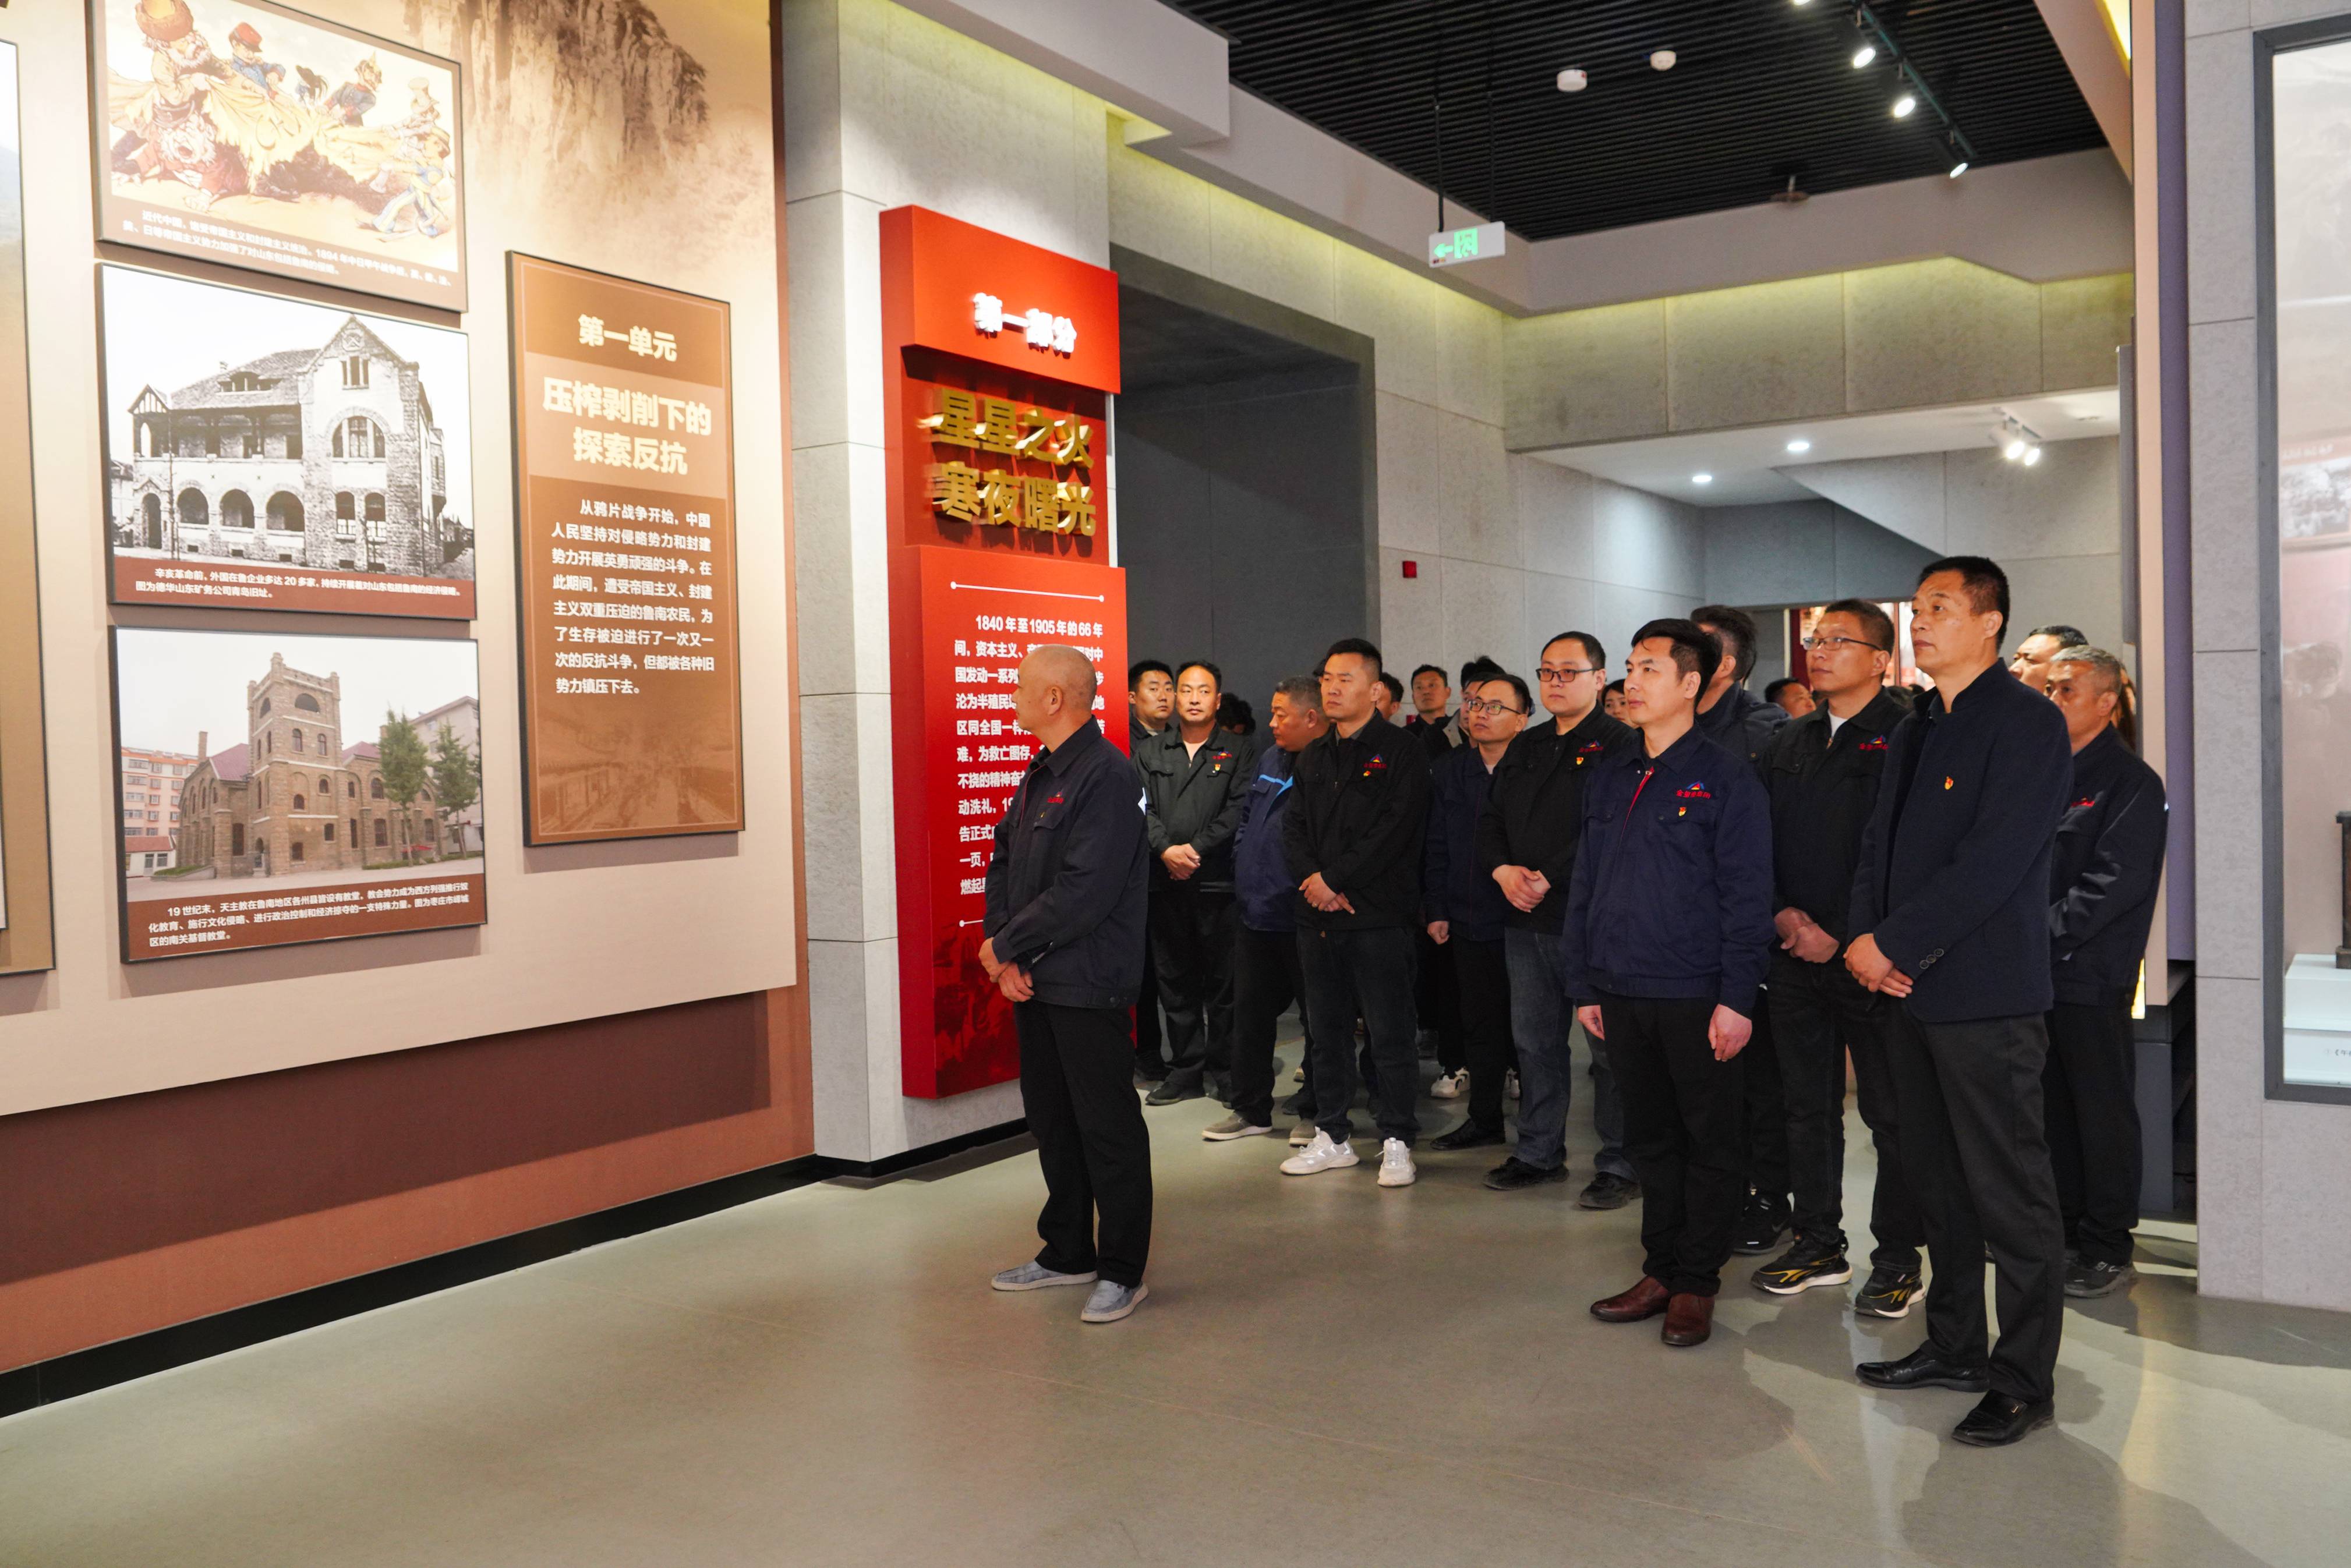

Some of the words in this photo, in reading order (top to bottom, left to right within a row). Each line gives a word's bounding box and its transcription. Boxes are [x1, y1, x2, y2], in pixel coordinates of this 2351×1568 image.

[578, 314, 678, 362] 第一单元
[542, 377, 712, 436] 压榨剥削下的
[929, 388, 1094, 469] 星星之火
[572, 426, 688, 476] 探索反抗
[579, 499, 711, 529] 从鸦片战争开始，中国
[932, 462, 1097, 537] 寒夜曙光
[551, 522, 711, 552] 人民坚持对侵略势力和封建
[553, 574, 713, 600] 此期间，遭受帝国主义、封建
[554, 626, 715, 647] 了生存被迫进行了一次又一
[556, 677, 641, 694] 势力镇压下去。
